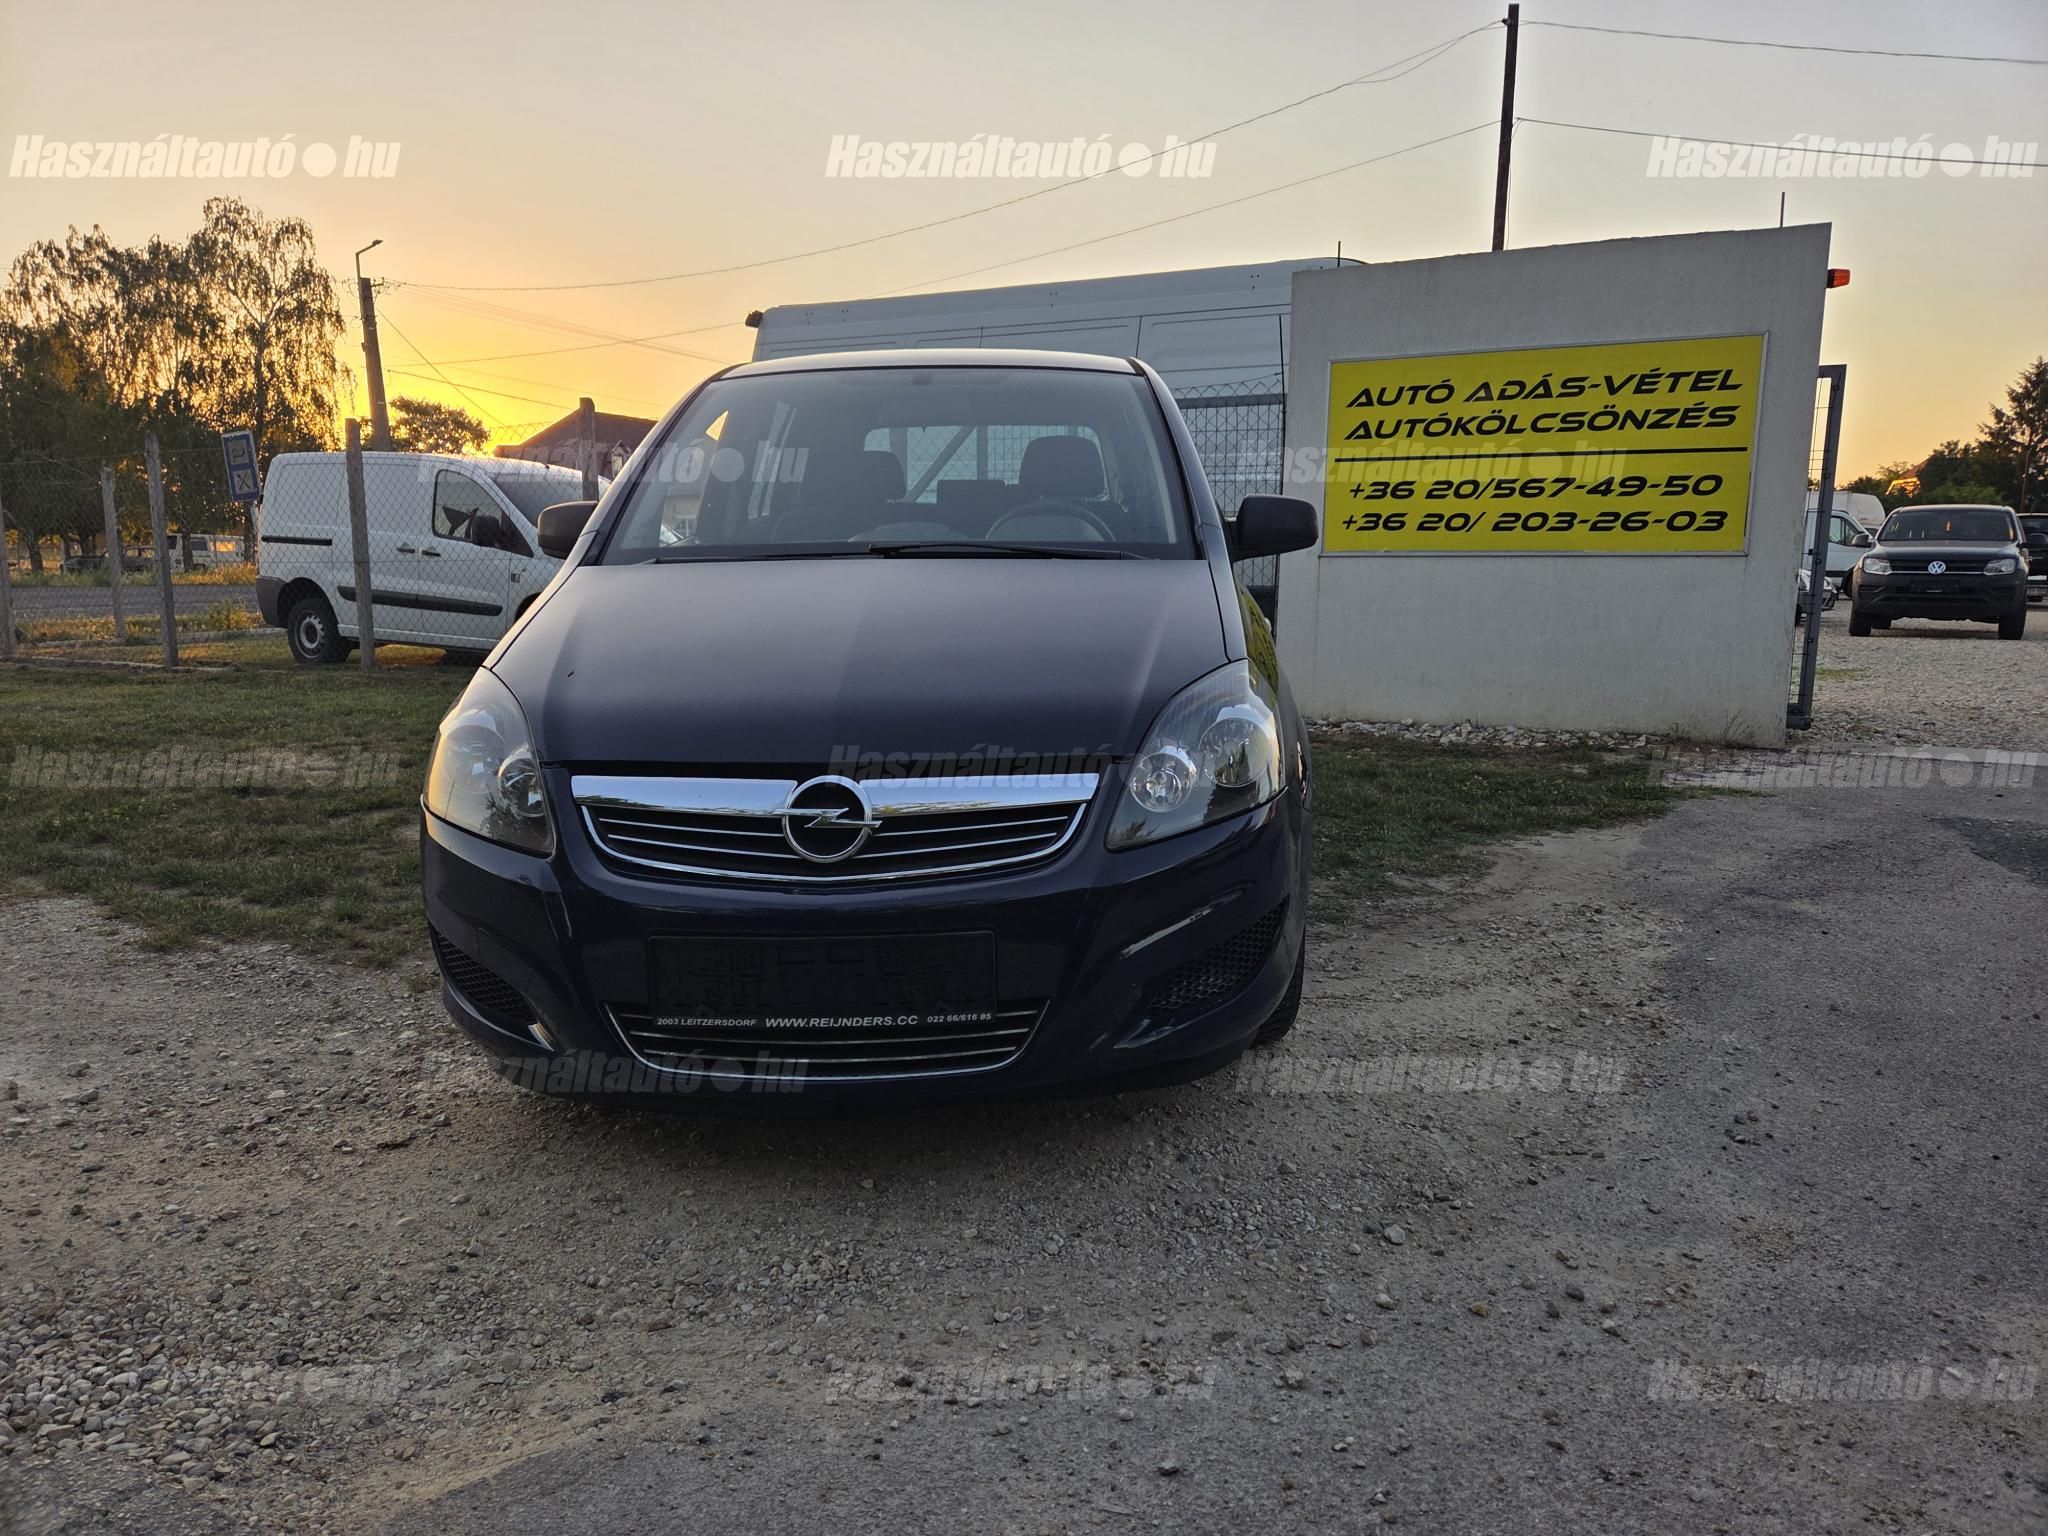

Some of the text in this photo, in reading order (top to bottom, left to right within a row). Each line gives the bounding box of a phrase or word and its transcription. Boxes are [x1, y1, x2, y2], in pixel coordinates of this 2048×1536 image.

[1346, 368, 1743, 408] AUTÓ ADÁS-VÉTEL
[1344, 402, 1741, 440] AUTÓKÖLCSÖNZÉS
[1350, 474, 1724, 500] +36 20/567-49-50
[1342, 510, 1728, 532] +36 20/ 203-26-03
[657, 1018, 679, 1026] 2003
[681, 1018, 757, 1027] LEITZERSDORF
[765, 1015, 918, 1028] WWW.REIJNDERS.CC
